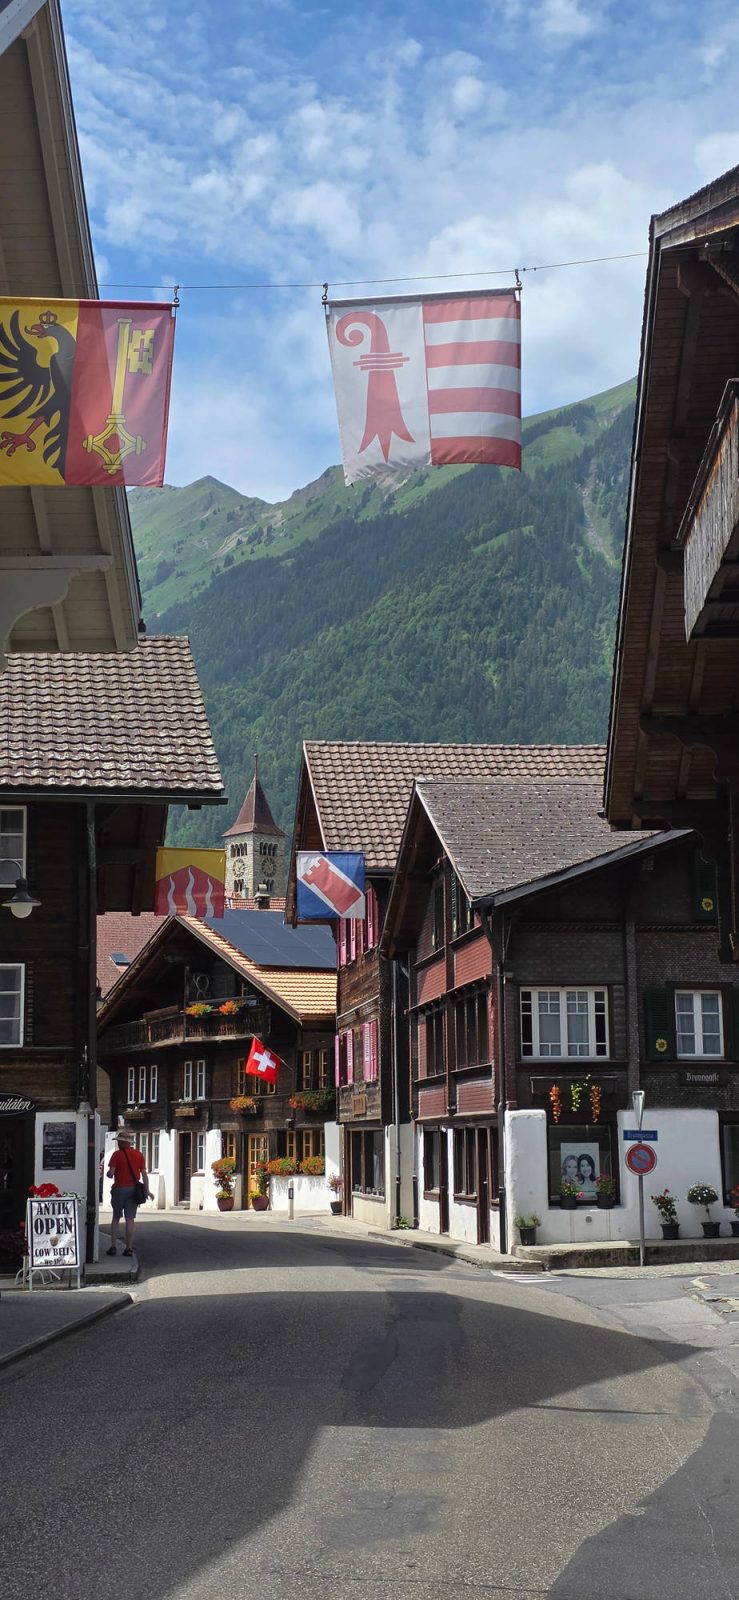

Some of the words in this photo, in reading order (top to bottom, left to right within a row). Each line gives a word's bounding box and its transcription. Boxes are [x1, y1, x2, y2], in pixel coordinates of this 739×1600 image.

[36, 1202, 70, 1215] ANTIK
[34, 1218, 73, 1235] OPEN
[35, 1248, 51, 1257] COW
